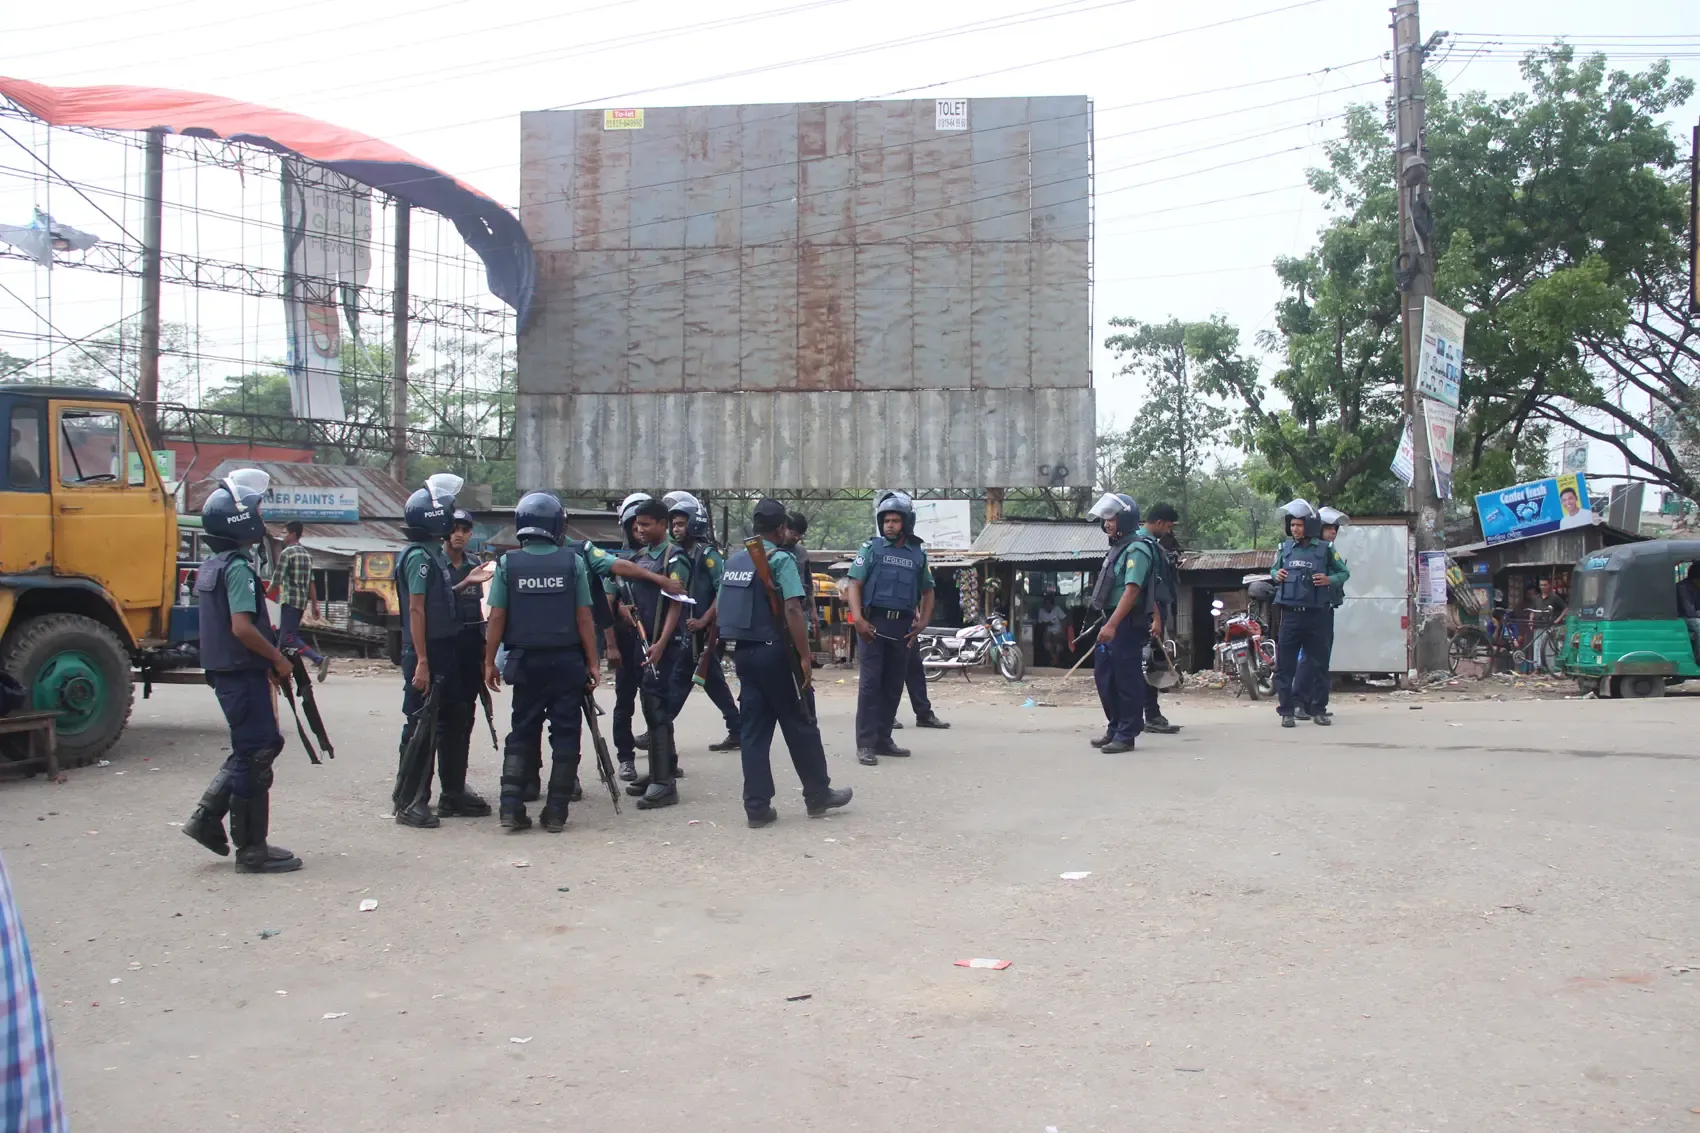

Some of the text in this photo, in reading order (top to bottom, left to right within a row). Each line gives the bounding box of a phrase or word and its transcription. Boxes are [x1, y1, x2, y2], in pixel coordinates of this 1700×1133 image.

[938, 101, 966, 116] TOLET
[294, 493, 335, 505] PAINTS
[227, 511, 251, 524] POLICE
[424, 509, 445, 518] POLICE
[722, 571, 753, 581] POLICE
[518, 577, 564, 589] POLICE
